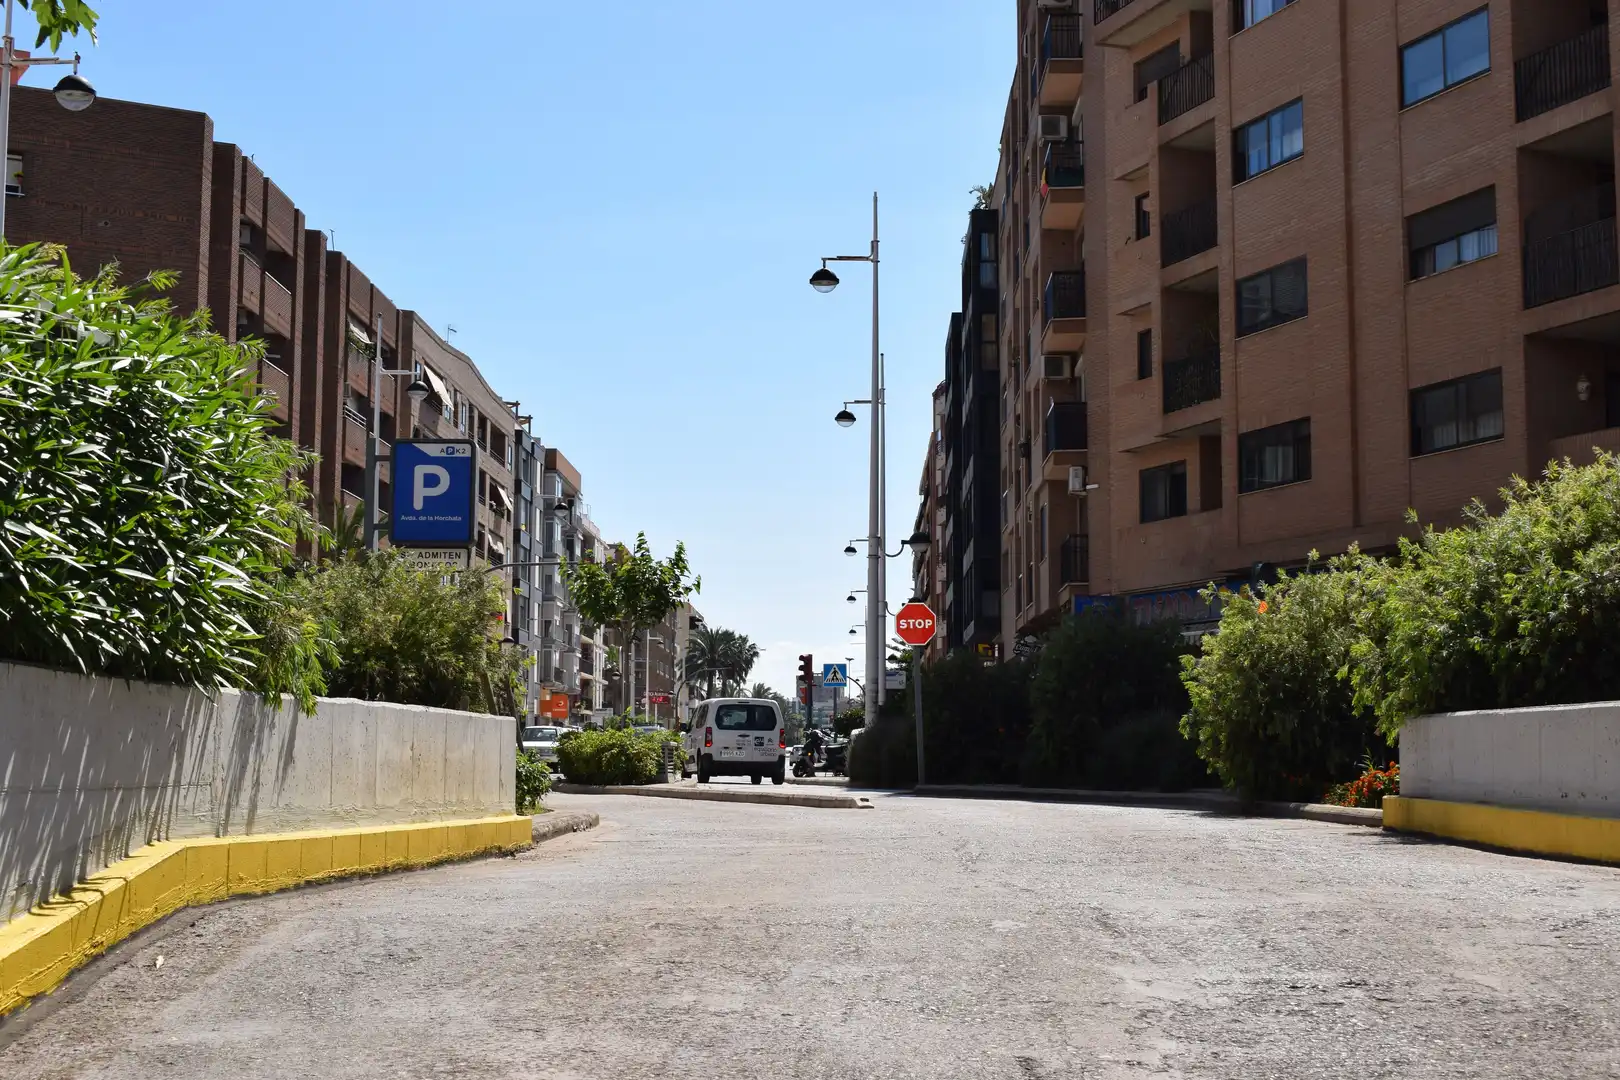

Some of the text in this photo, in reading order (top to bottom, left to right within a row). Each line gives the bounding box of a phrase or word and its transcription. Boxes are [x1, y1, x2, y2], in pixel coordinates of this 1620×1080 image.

[413, 464, 450, 511] P
[417, 551, 461, 559] ADMITEN
[899, 619, 933, 629] STOP
